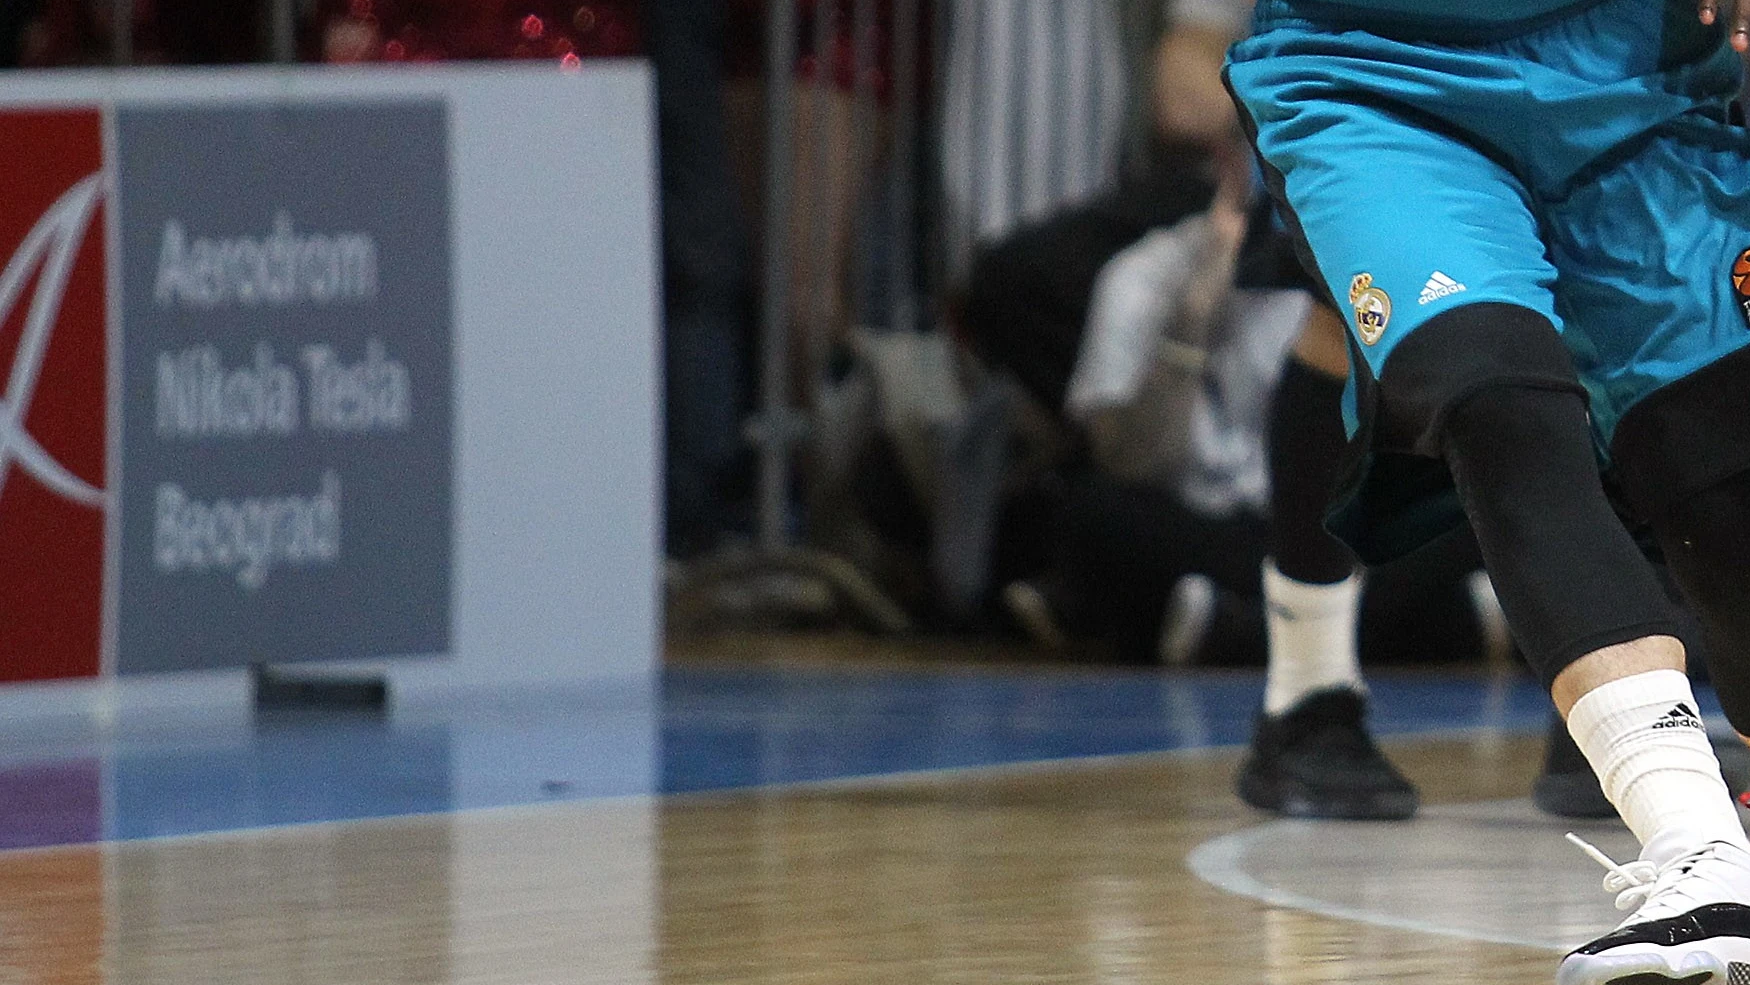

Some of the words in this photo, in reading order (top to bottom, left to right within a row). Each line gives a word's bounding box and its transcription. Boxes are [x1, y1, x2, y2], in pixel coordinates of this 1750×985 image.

[154, 211, 379, 304] Aerodrom
[1417, 282, 1468, 306] adidas
[156, 343, 300, 440] Nikola
[305, 337, 412, 432] Tesla
[154, 472, 342, 589] Beograd
